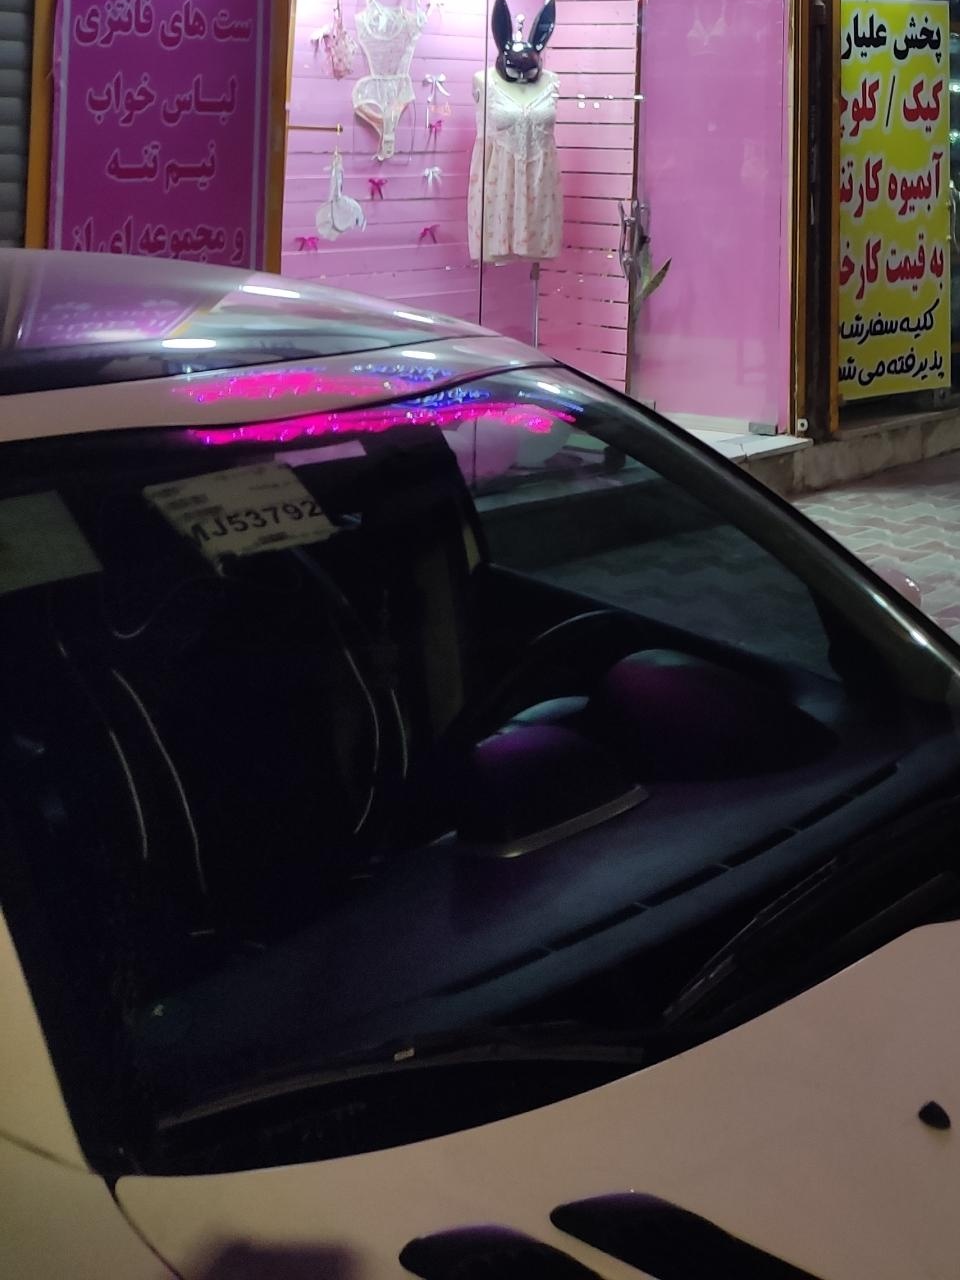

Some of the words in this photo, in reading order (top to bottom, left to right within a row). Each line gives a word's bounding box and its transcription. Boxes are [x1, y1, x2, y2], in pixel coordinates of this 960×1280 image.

[212, 10, 251, 41] ست
[840, 13, 887, 59] علیار
[893, 16, 941, 63] پخش
[86, 71, 156, 126] خواب
[161, 73, 238, 126] لباس
[902, 79, 943, 132] کیک
[105, 141, 160, 182] تنه
[163, 140, 217, 193] نیم
[888, 152, 943, 215] آبمیوه
[839, 158, 883, 218] کارتن
[138, 223, 226, 263] مجموعه
[230, 226, 245, 263] و
[886, 233, 925, 292] قیمت
[839, 238, 882, 300] کارخ
[930, 245, 944, 290] به
[839, 312, 898, 345] سفارشا
[858, 360, 886, 386] می
[887, 347, 945, 381] پذیرفته
